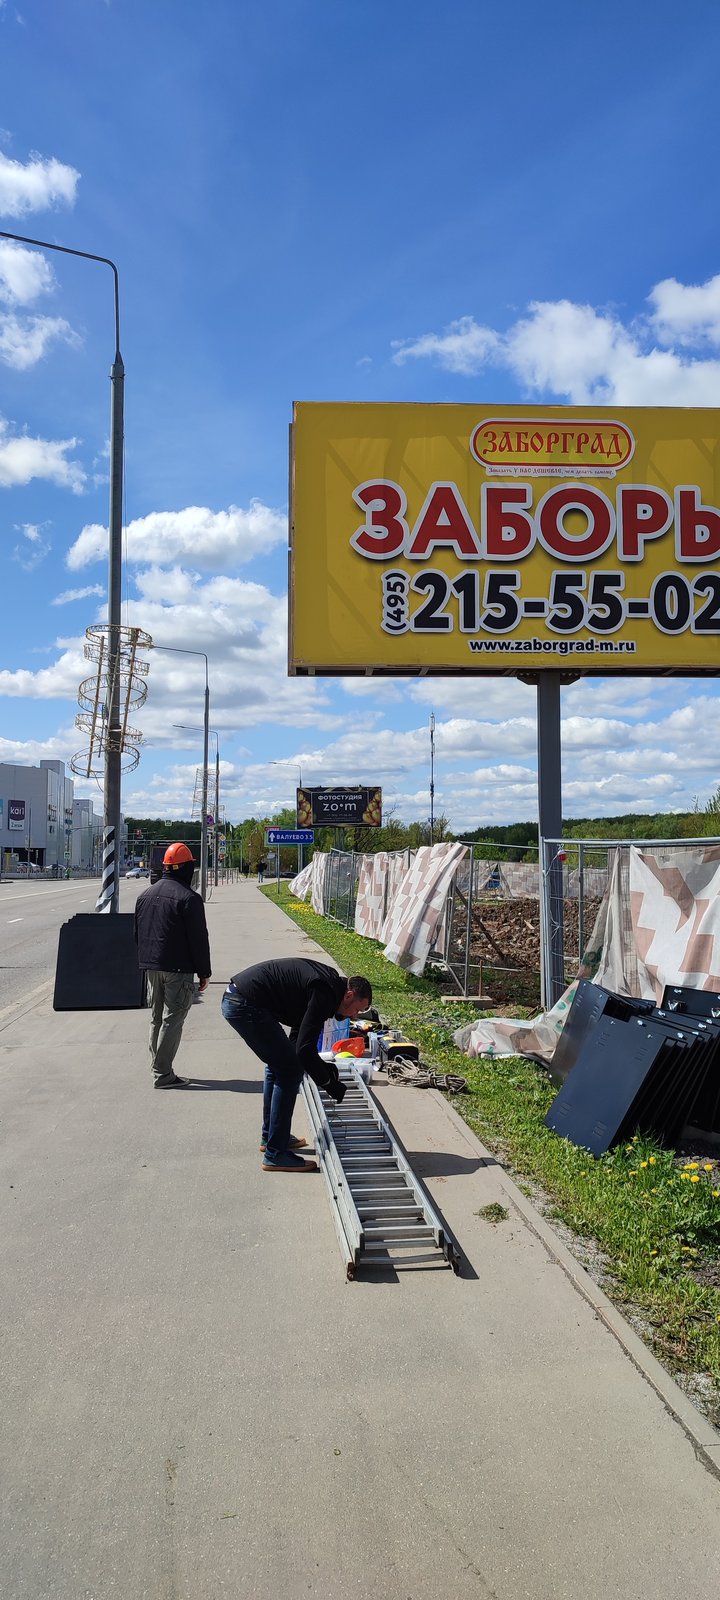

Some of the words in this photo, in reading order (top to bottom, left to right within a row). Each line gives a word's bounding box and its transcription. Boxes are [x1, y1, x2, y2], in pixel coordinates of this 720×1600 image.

[482, 430, 623, 459] ЗАБОРГРАД
[385, 573, 407, 631] (495)
[412, 573, 720, 630] 215-55-02
[470, 640, 635, 653] www.zaborgrad-m.ru
[10, 806, 24, 815] kari
